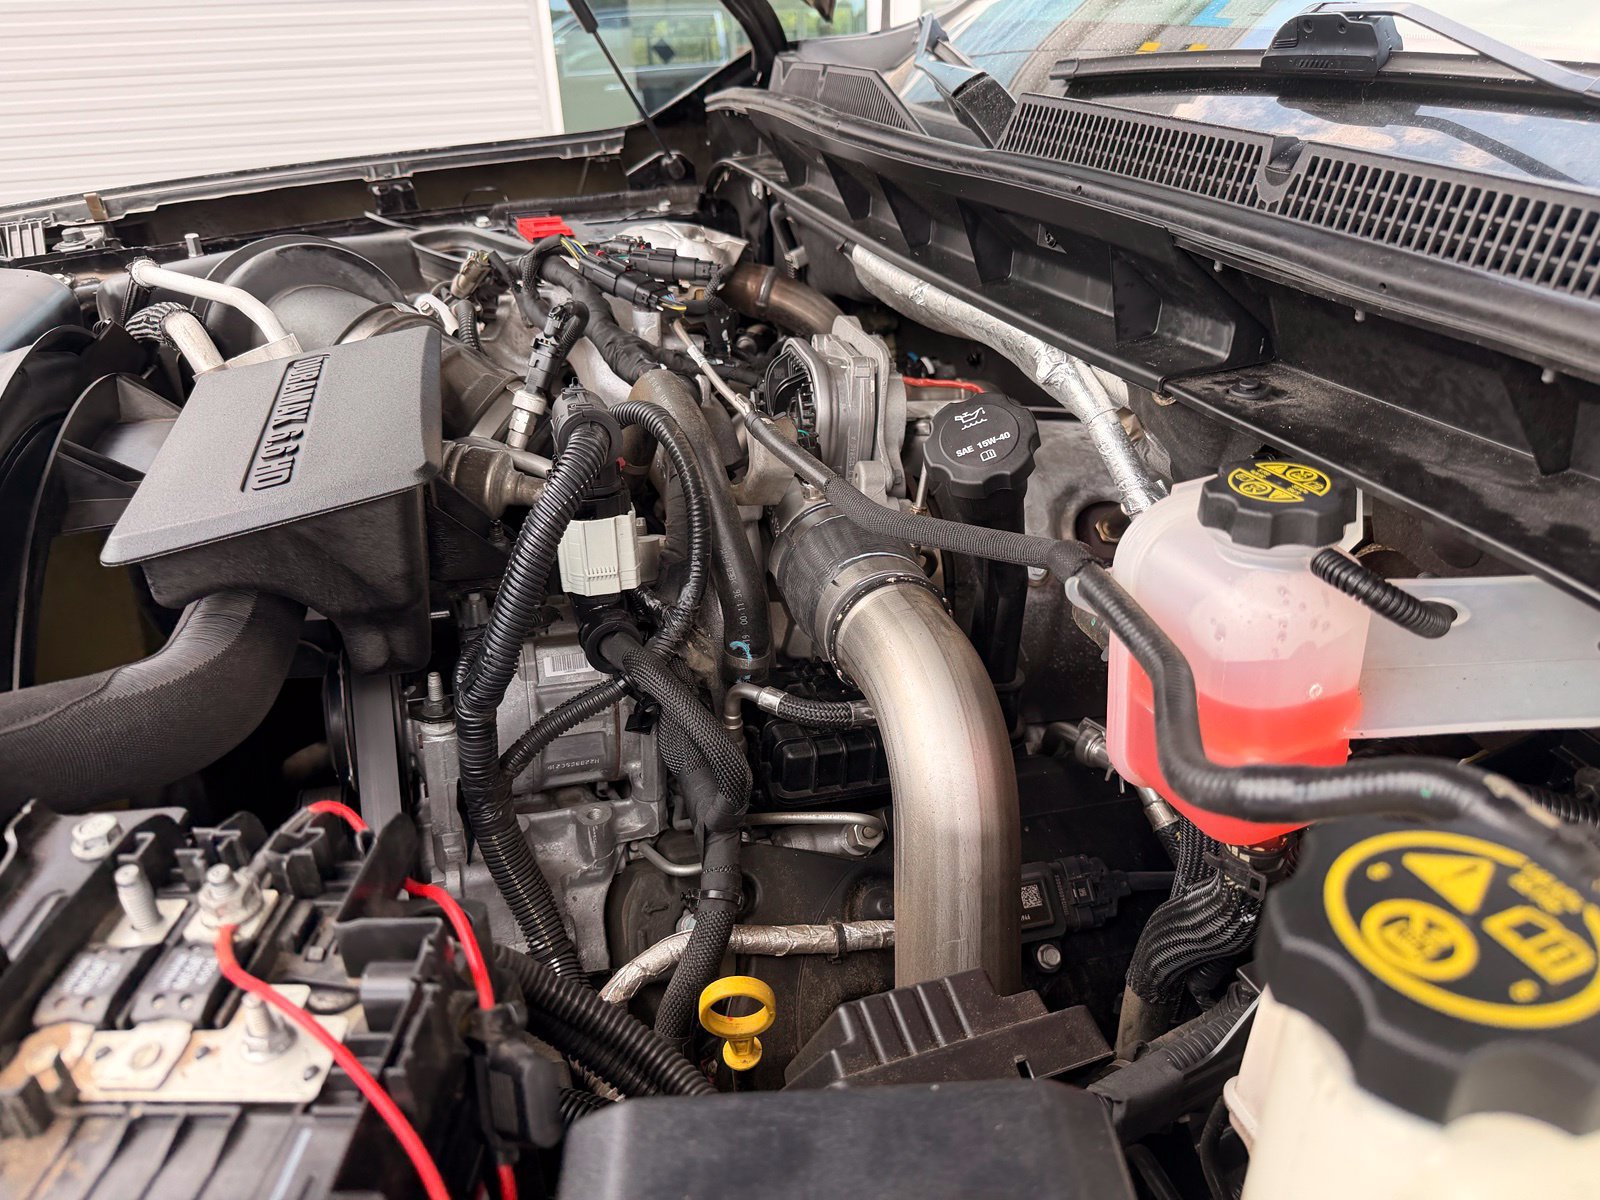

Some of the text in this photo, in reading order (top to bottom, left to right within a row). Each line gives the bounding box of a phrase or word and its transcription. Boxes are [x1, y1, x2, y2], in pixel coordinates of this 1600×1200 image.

[272, 356, 324, 430] DURAMAX
[955, 431, 1011, 457] SAE 15W-40
